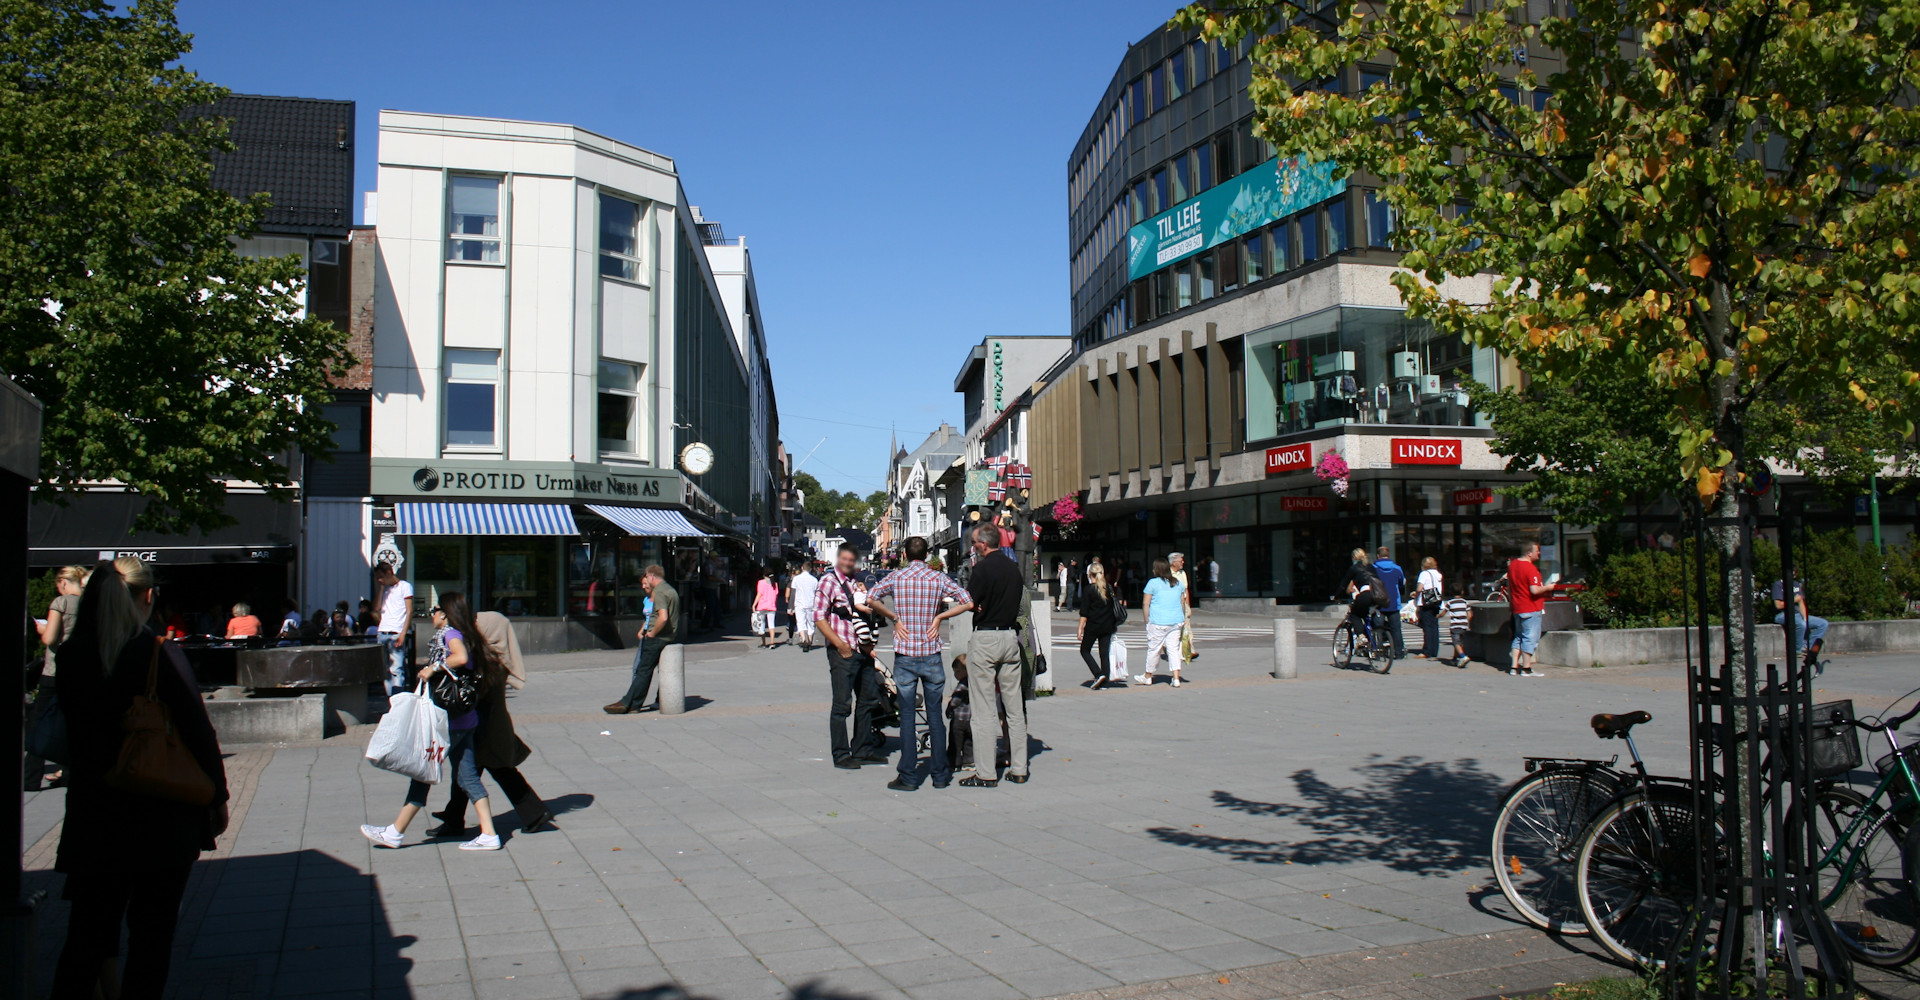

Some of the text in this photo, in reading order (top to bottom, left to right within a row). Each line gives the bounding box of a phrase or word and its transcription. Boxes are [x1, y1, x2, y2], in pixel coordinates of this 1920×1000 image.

[1157, 201, 1201, 240] TIL LEIE
[993, 342, 1003, 414] DOKKEN
[1269, 449, 1306, 467] LINDEX
[1399, 445, 1457, 458] LINDEX
[442, 472, 526, 490] PROTID
[536, 474, 603, 493] Urmaker
[642, 480, 659, 497] AS
[1286, 498, 1323, 508] LINDEX
[1456, 490, 1485, 501] LINDEX
[251, 551, 269, 559] BAR
